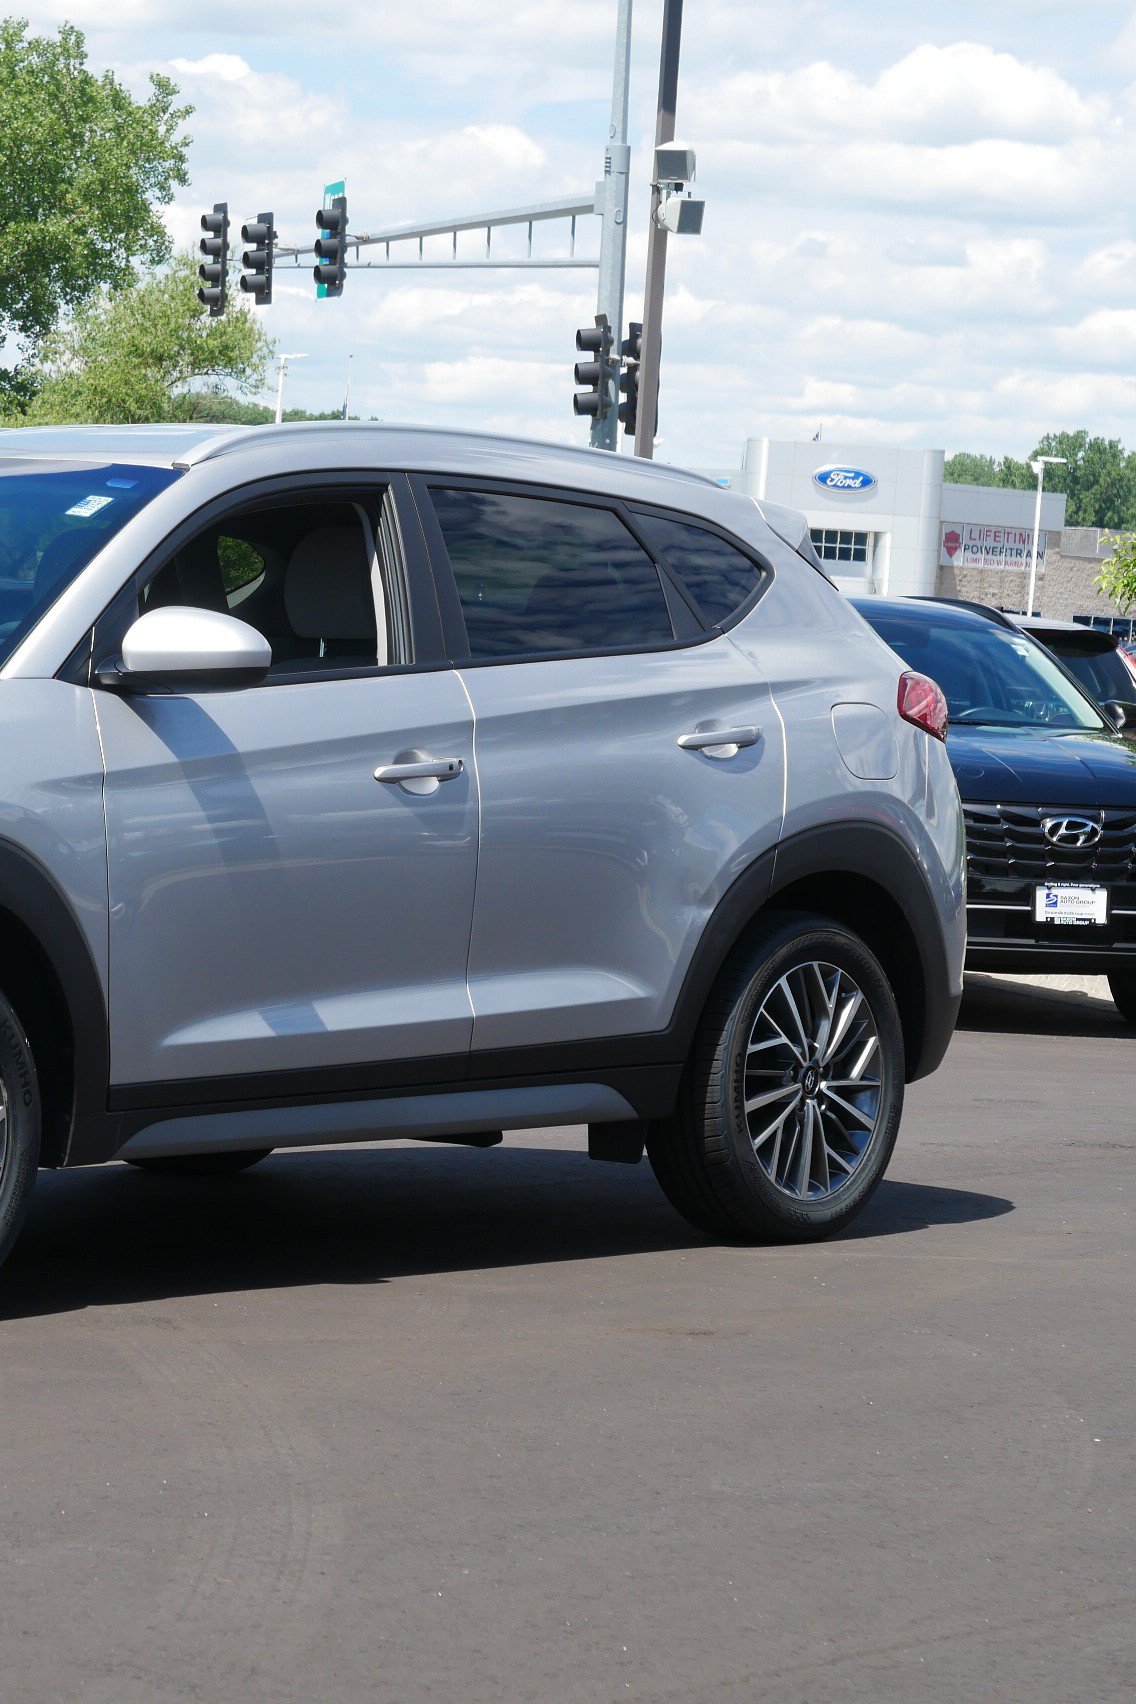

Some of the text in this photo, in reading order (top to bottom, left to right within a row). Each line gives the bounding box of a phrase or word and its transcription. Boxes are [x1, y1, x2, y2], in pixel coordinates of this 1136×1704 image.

[826, 471, 863, 487] Ford
[969, 528, 1039, 546] LIFETIM
[963, 544, 1044, 560] POWERTRAN
